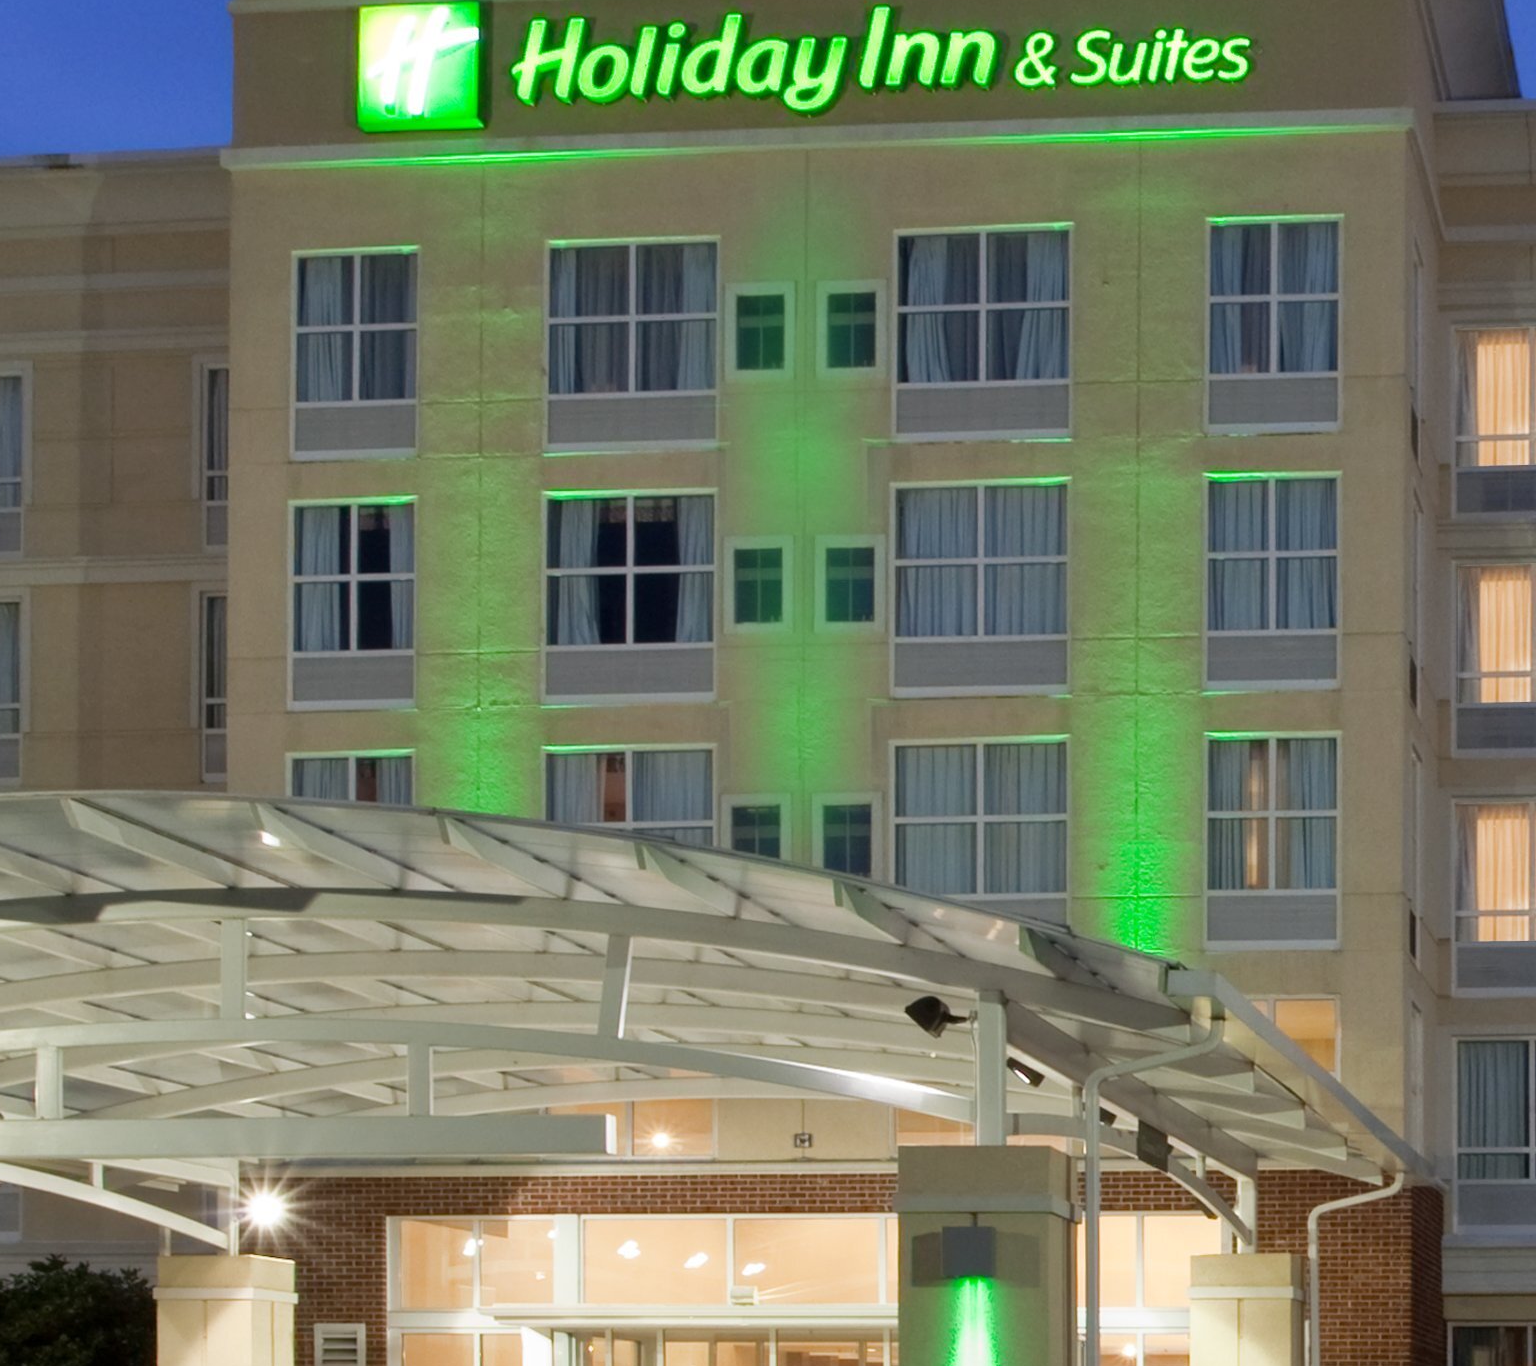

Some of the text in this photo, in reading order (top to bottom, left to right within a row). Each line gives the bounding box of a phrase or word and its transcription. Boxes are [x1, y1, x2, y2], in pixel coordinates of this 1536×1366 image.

[511, 5, 1252, 113] Holiday Inn & Suites
